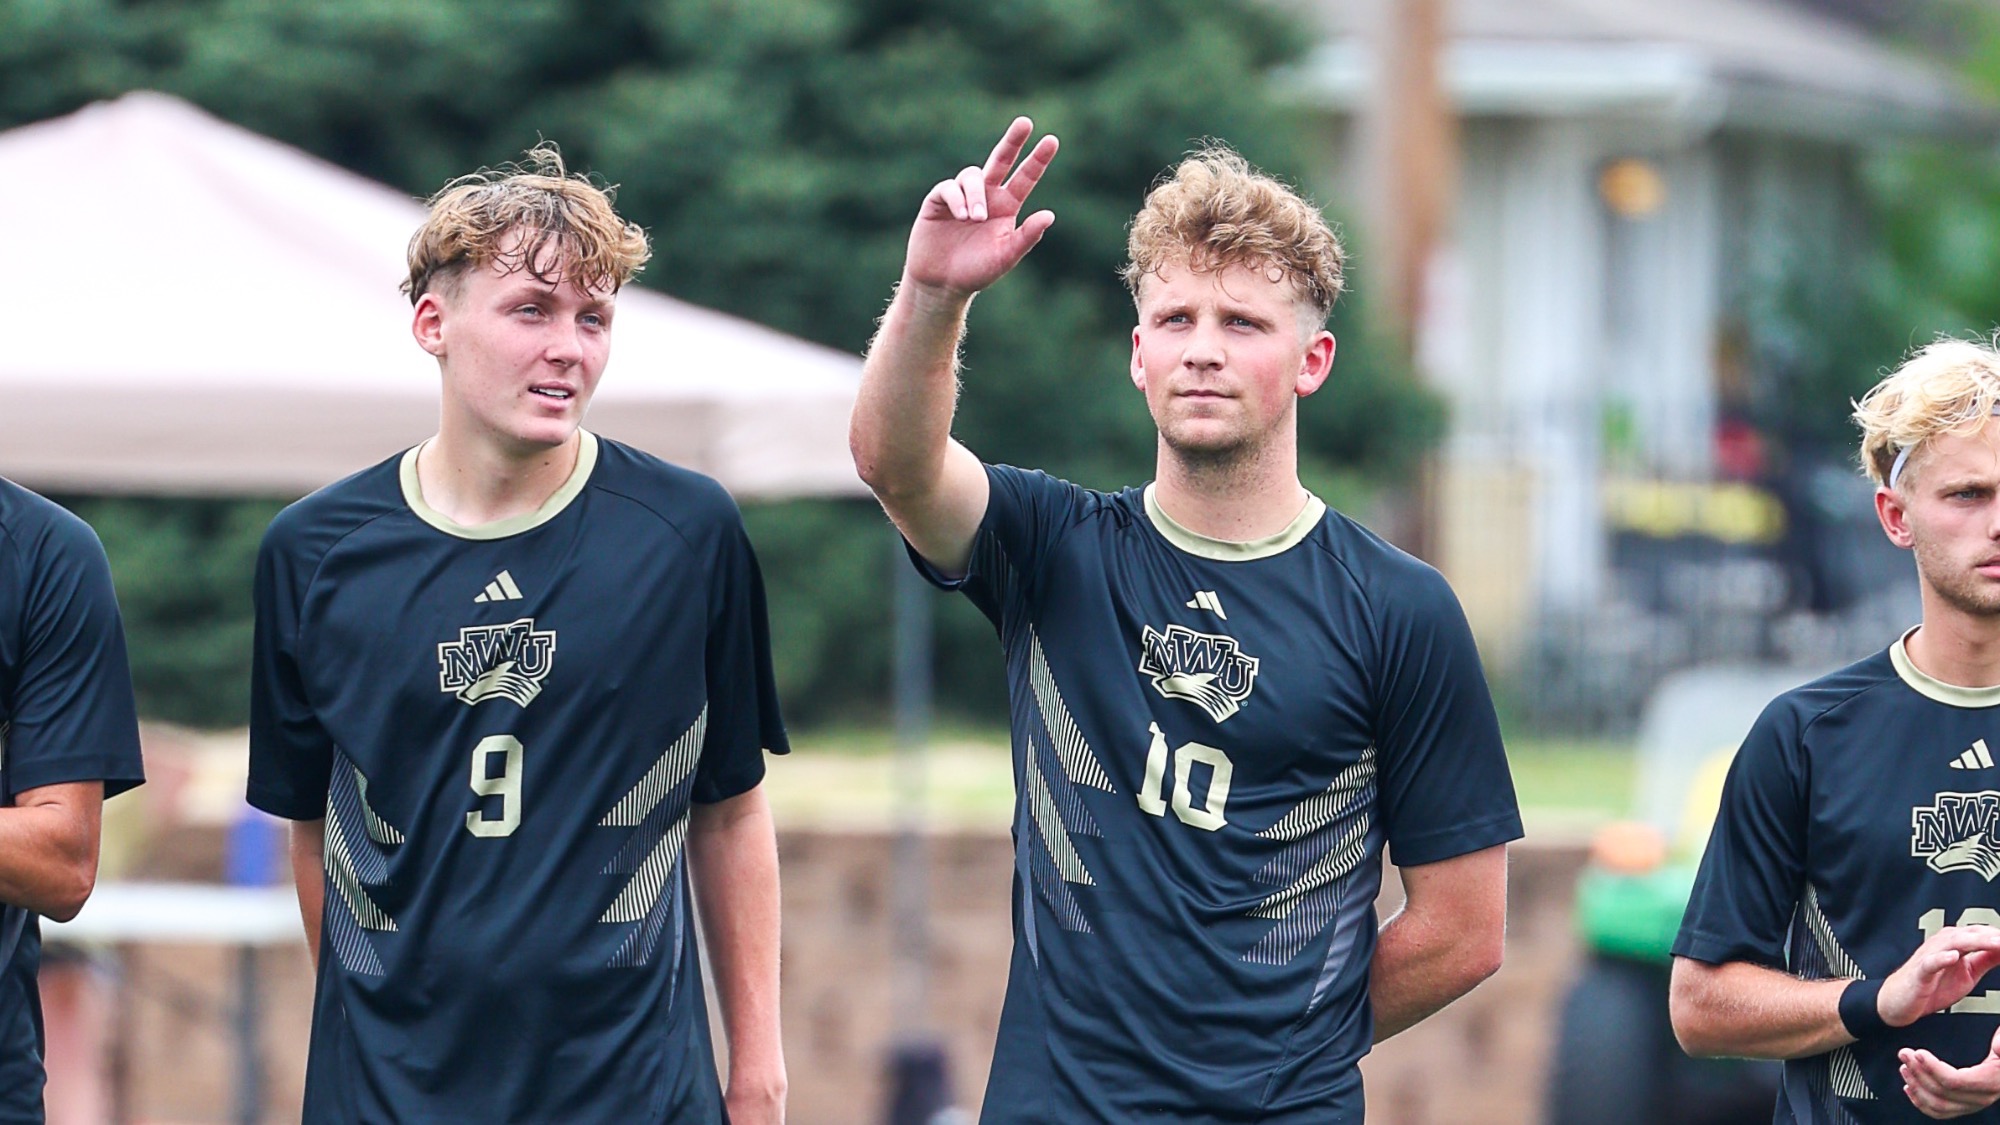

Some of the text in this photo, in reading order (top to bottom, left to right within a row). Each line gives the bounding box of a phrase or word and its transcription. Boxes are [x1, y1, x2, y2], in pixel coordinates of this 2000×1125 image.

[438, 618, 557, 692] NWU
[1138, 624, 1260, 698] NWU
[466, 735, 524, 838] 9
[1136, 721, 1234, 832] 10
